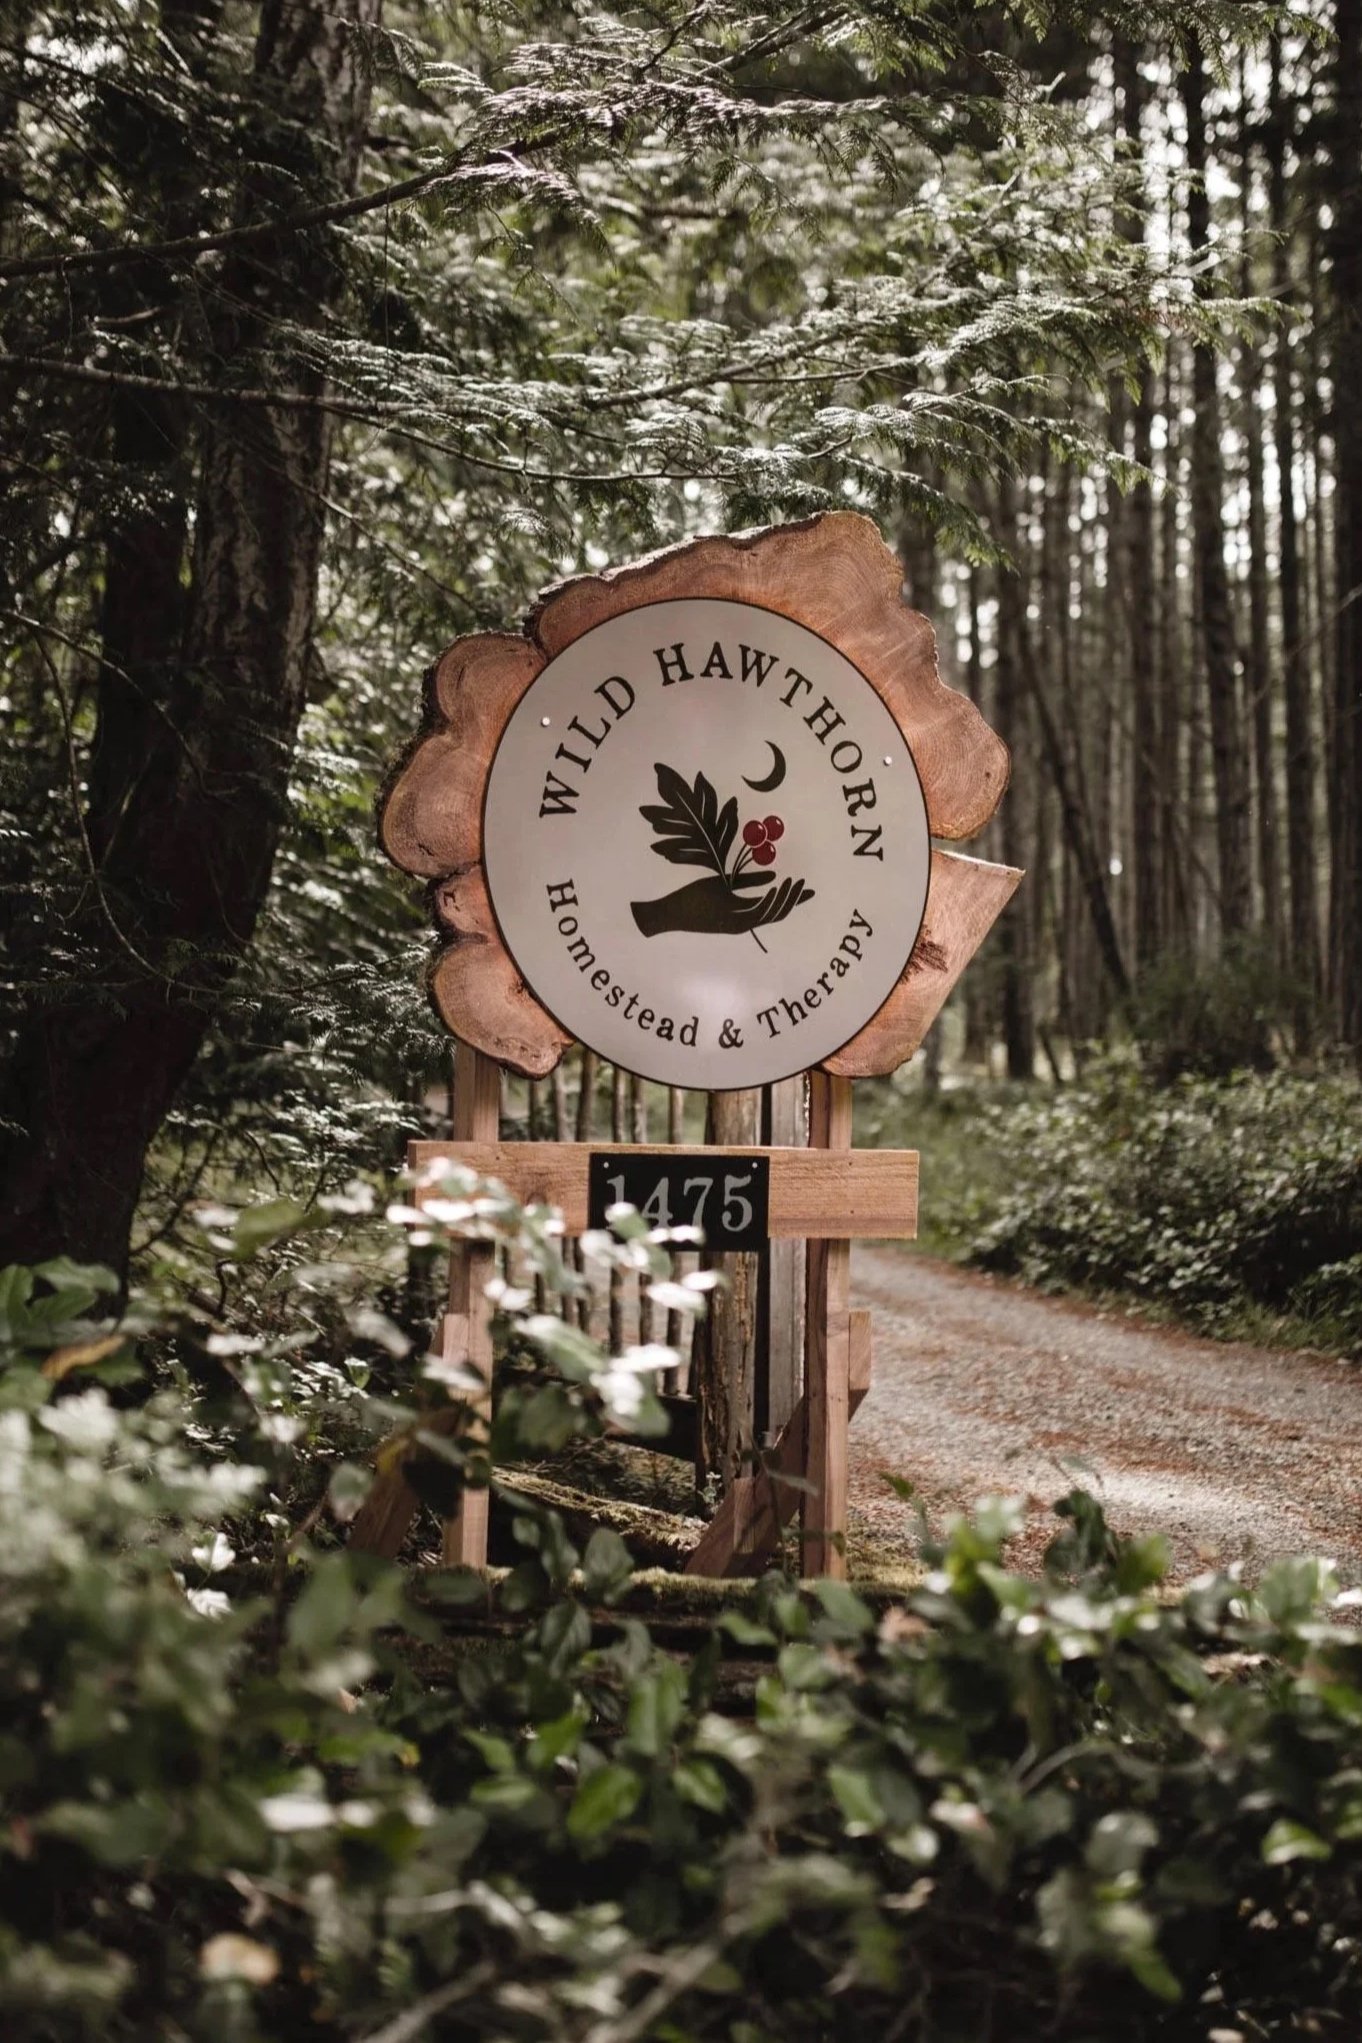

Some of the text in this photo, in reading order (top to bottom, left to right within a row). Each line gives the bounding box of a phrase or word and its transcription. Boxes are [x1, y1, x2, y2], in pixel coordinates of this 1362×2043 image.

[539, 641, 884, 862] WILD HAWTHORN
[546, 878, 873, 1049] Homestead & Therapy
